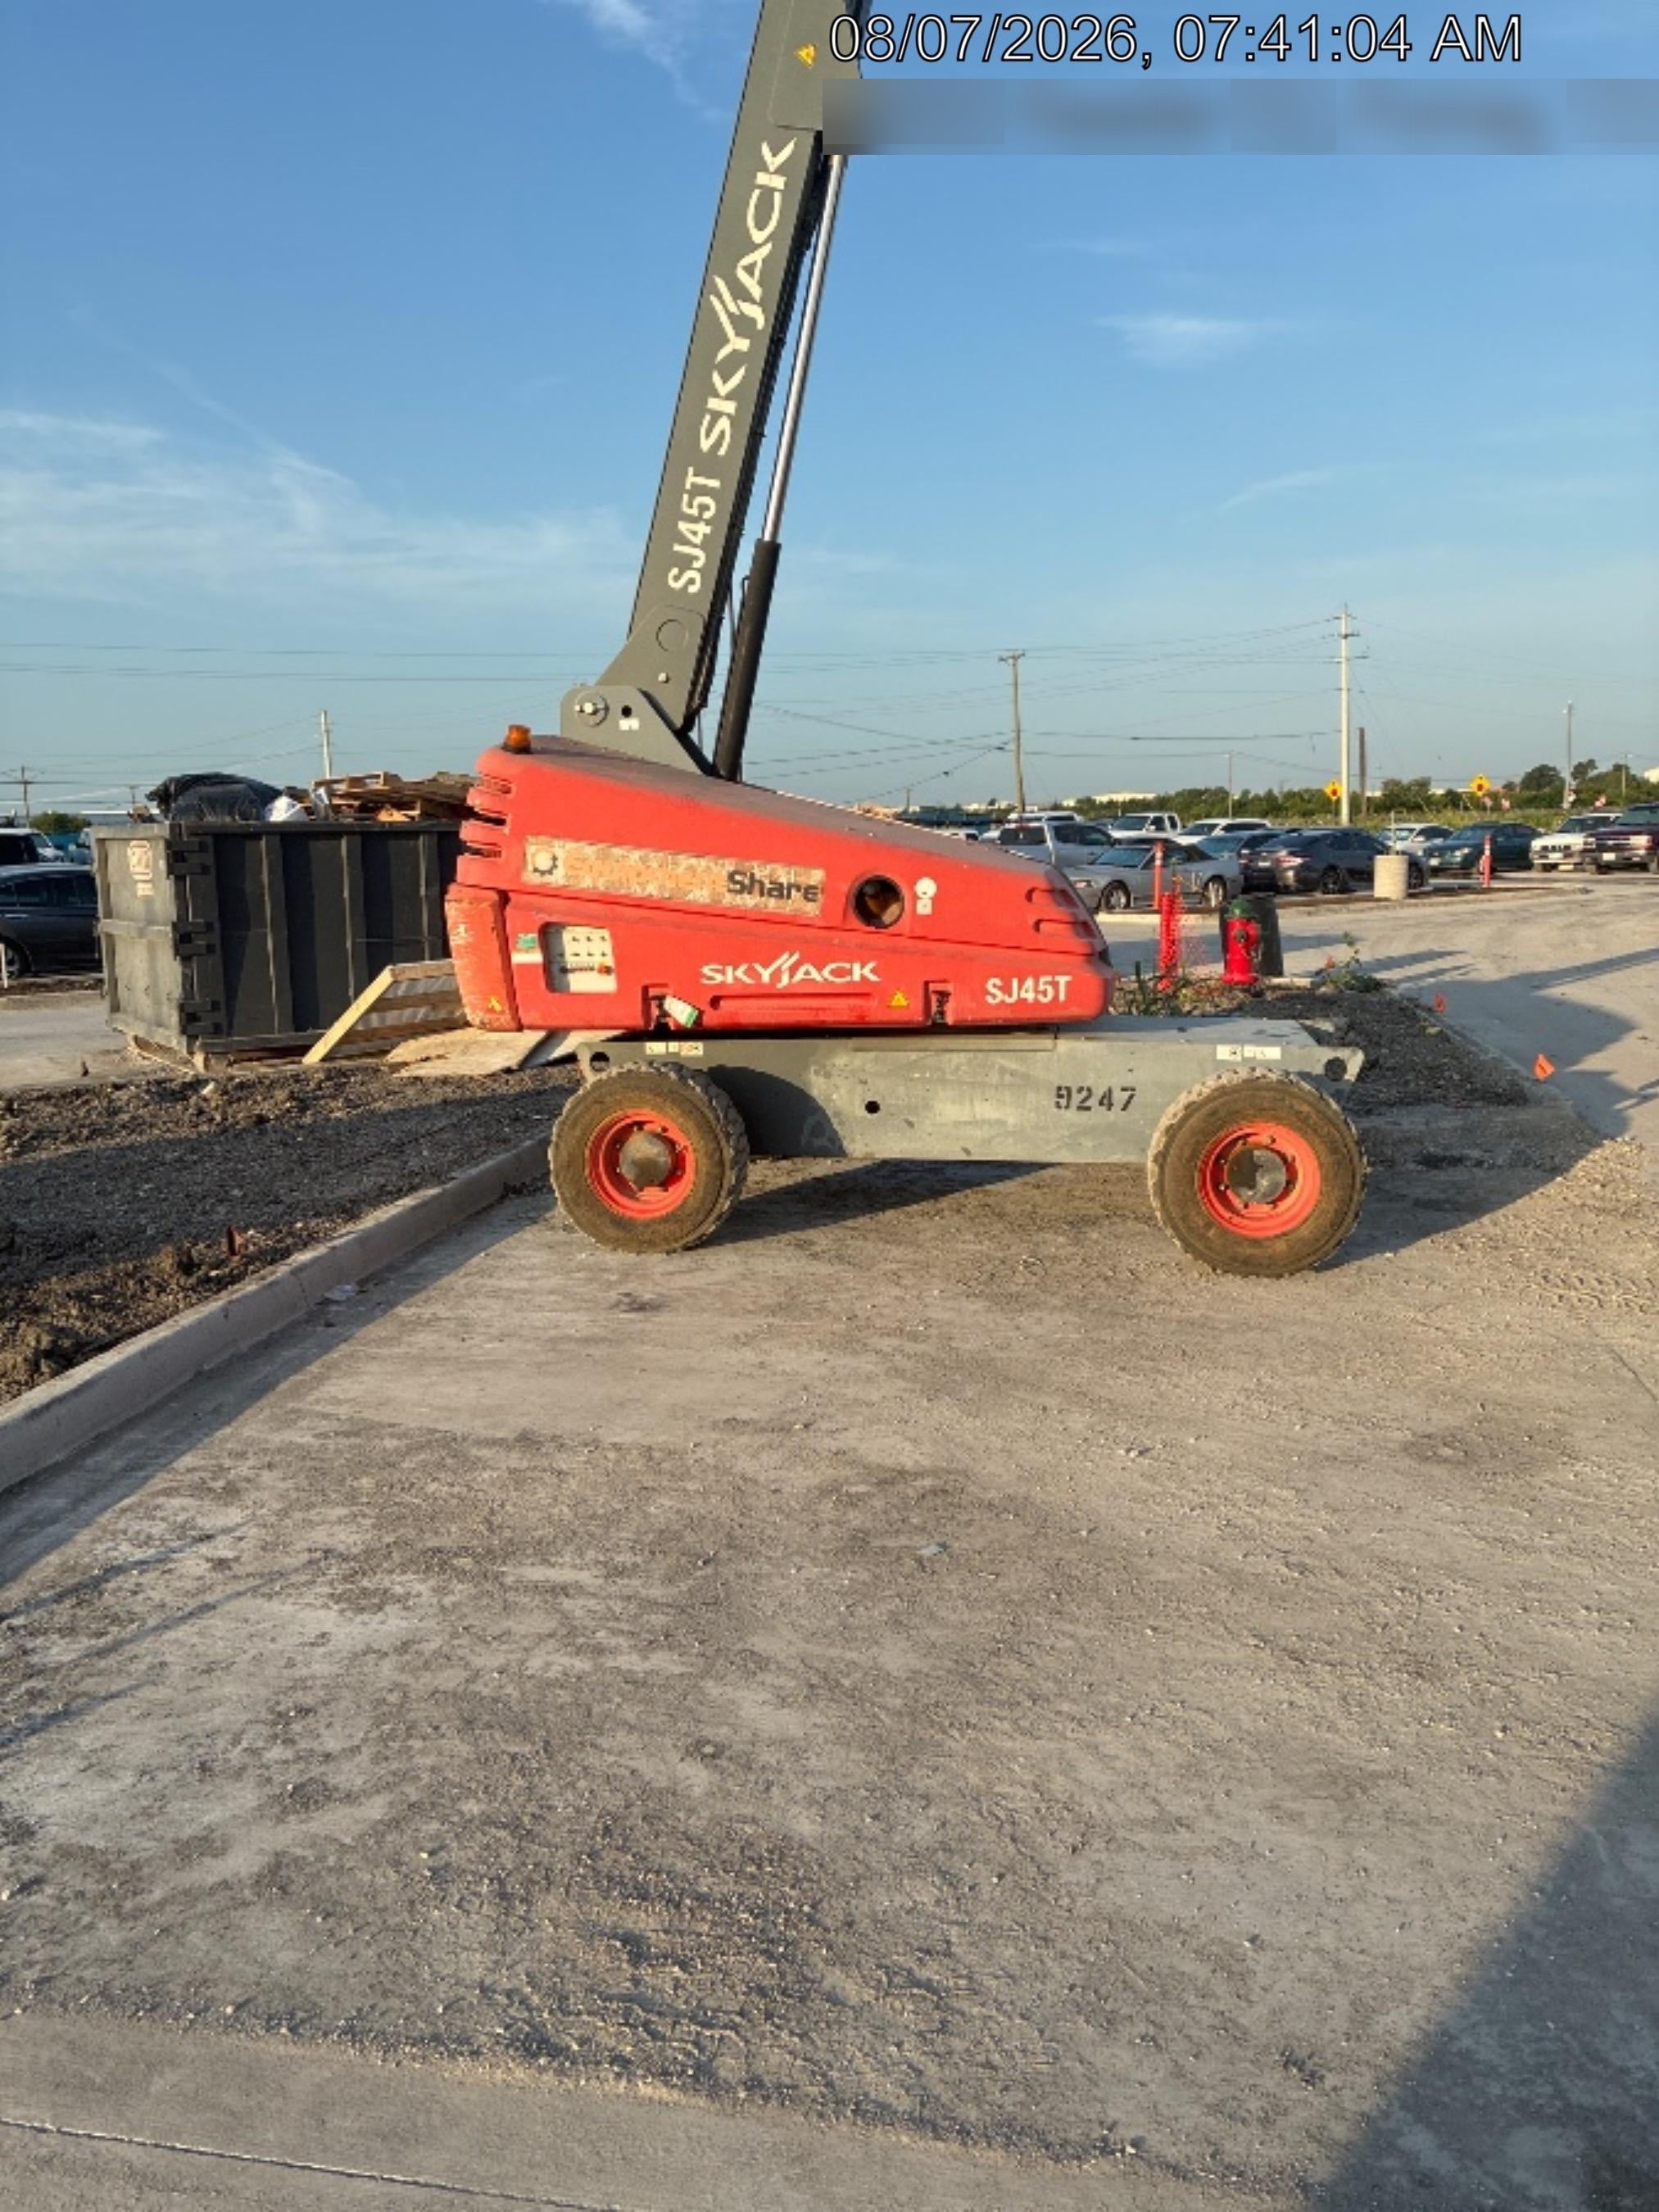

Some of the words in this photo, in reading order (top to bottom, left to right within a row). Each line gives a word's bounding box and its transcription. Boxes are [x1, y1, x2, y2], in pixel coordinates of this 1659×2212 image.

[668, 467, 721, 593] SJ45T
[700, 137, 797, 456] SKYJACK
[700, 950, 881, 989] SKYJACK
[986, 975, 1072, 1004] SJ45T
[1054, 1086, 1137, 1113] 9247
